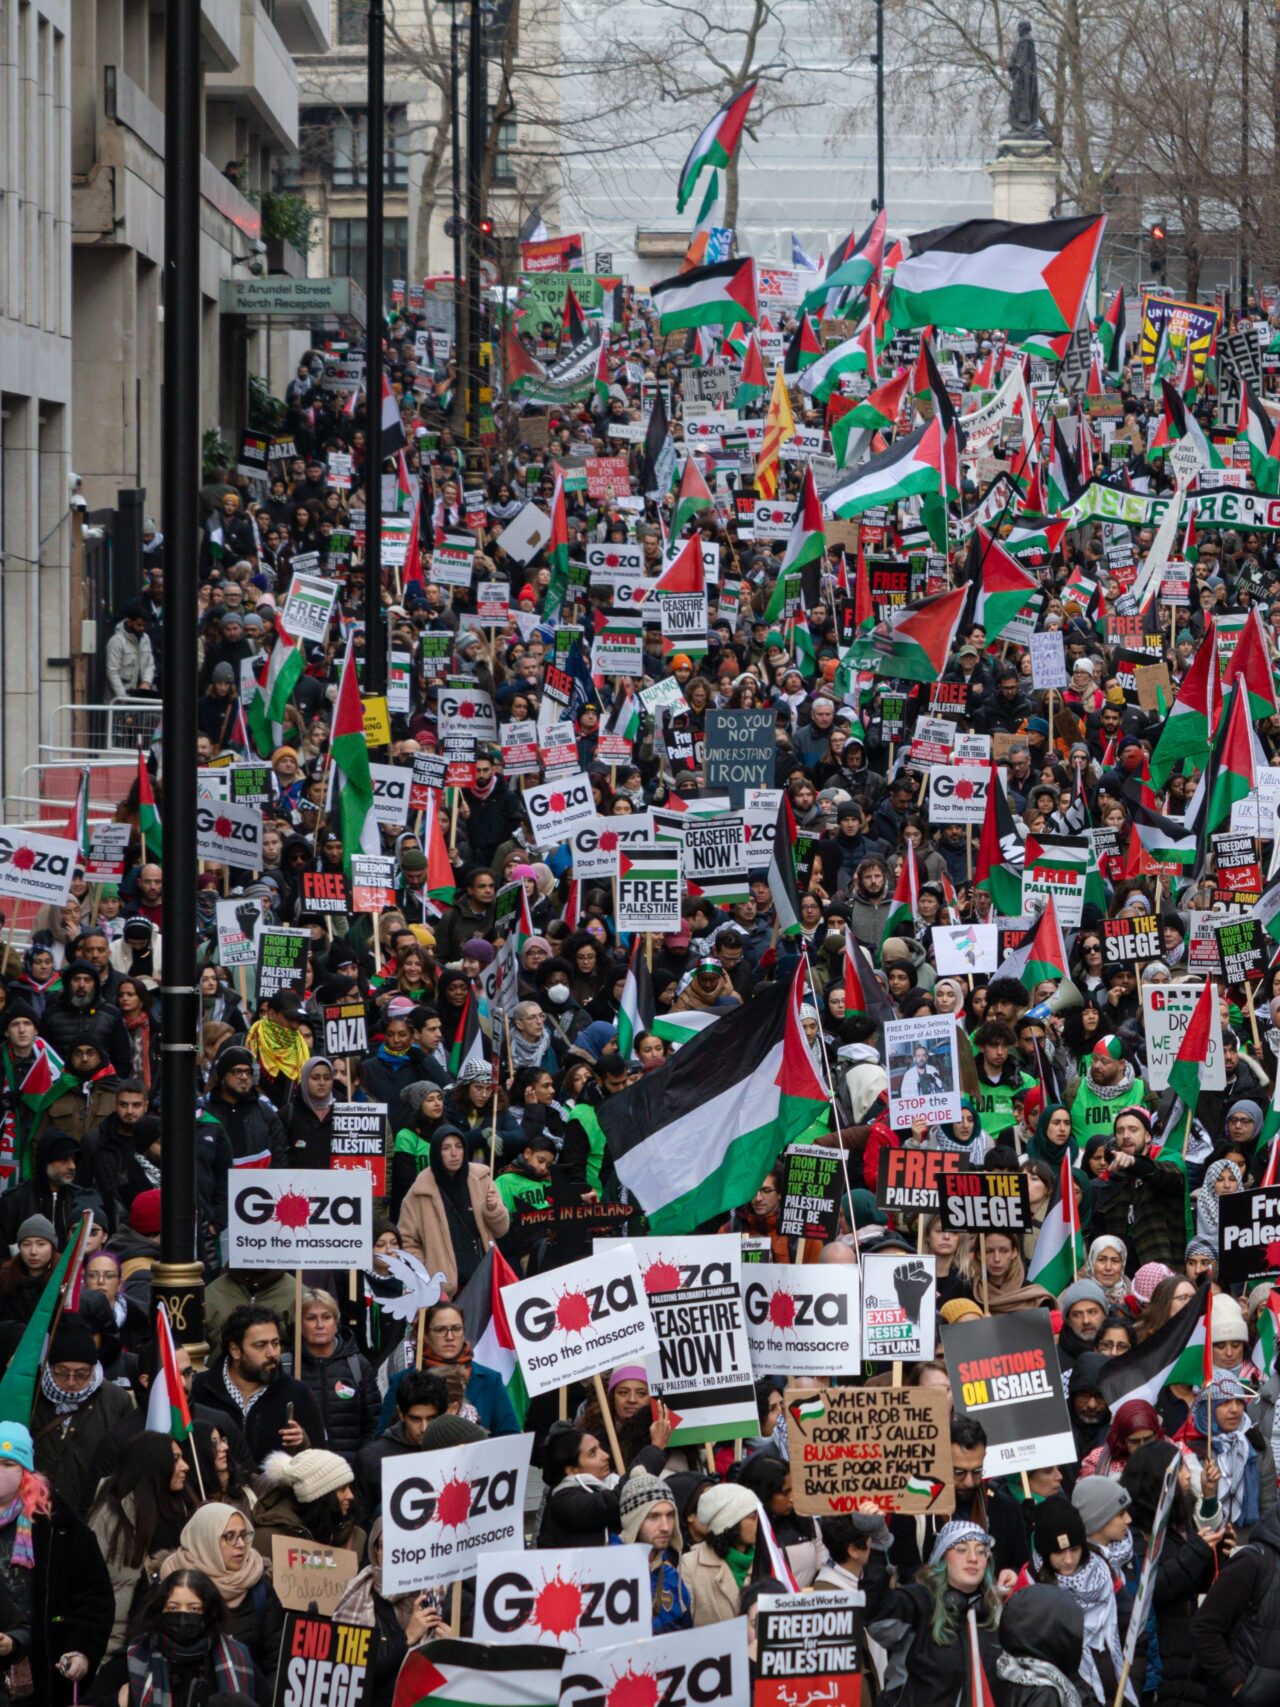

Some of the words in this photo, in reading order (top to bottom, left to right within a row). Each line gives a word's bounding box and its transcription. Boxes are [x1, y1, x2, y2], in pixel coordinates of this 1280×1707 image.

[236, 284, 244, 294] 2
[247, 284, 291, 294] Arundel
[295, 284, 332, 294] Street
[238, 299, 269, 309] North
[274, 299, 330, 310] Reception
[1147, 307, 1212, 329] UNIVERSITY
[599, 459, 625, 468] VOTES
[662, 598, 703, 613] CEASEFIRE
[668, 611, 701, 630] NOW!
[718, 716, 738, 729] DO
[743, 715, 772, 729] YOU
[729, 729, 757, 741] NOT
[704, 747, 772, 762] UNDERSTAND
[709, 764, 768, 783] IRONY
[620, 880, 678, 902] FREE
[620, 903, 679, 914] PALESTINE
[326, 1016, 368, 1055] GAZA
[887, 1025, 902, 1033] FREE
[914, 1022, 926, 1031] Abu
[889, 1033, 914, 1042] Director
[933, 1028, 950, 1037] Shifa
[898, 1098, 926, 1111] STOP
[929, 1096, 949, 1108] the
[896, 1110, 953, 1127] GENOCIDE
[1085, 1105, 1111, 1126] FOA
[790, 1156, 817, 1170] FROM
[819, 1159, 838, 1173] THE
[946, 1174, 980, 1198] END
[985, 1173, 1021, 1197] THE
[234, 1186, 362, 1226] Gza
[785, 1195, 834, 1212] PALESTINE
[949, 1195, 1025, 1229] SIEGE
[521, 1211, 555, 1226] MADE
[559, 1208, 574, 1221] IN
[576, 1203, 634, 1219] ENGLAND
[781, 1220, 803, 1237] FREE
[236, 1234, 267, 1251] Stop
[270, 1235, 292, 1248] the
[295, 1236, 363, 1249] massacre
[866, 1309, 906, 1325] EXIST.
[867, 1325, 913, 1340] RESIST.
[868, 1340, 920, 1357] RETURN.
[958, 1348, 1047, 1385] SANCTIONS
[962, 1381, 990, 1407] ON
[993, 1368, 1054, 1401] ISRAEL
[881, 1390, 911, 1406] THE
[828, 1408, 866, 1425] RICH
[868, 1408, 899, 1424] ROB
[903, 1407, 933, 1423] THE
[812, 1427, 852, 1444] POOR
[887, 1424, 938, 1442] CALLED
[803, 1443, 882, 1461] BUSINESS.
[884, 1443, 936, 1459] WHEN
[803, 1463, 838, 1479] THE
[842, 1461, 882, 1477] POOR
[886, 1459, 934, 1476] FIGHT
[804, 1479, 840, 1497] BACK
[861, 1475, 908, 1492] CALLED
[287, 1547, 337, 1570] FREE
[482, 1566, 640, 1631] Gza
[767, 1611, 854, 1642] FREEDOM
[291, 1619, 332, 1660] END
[336, 1625, 371, 1667] THE
[761, 1646, 857, 1676] PALESTINE
